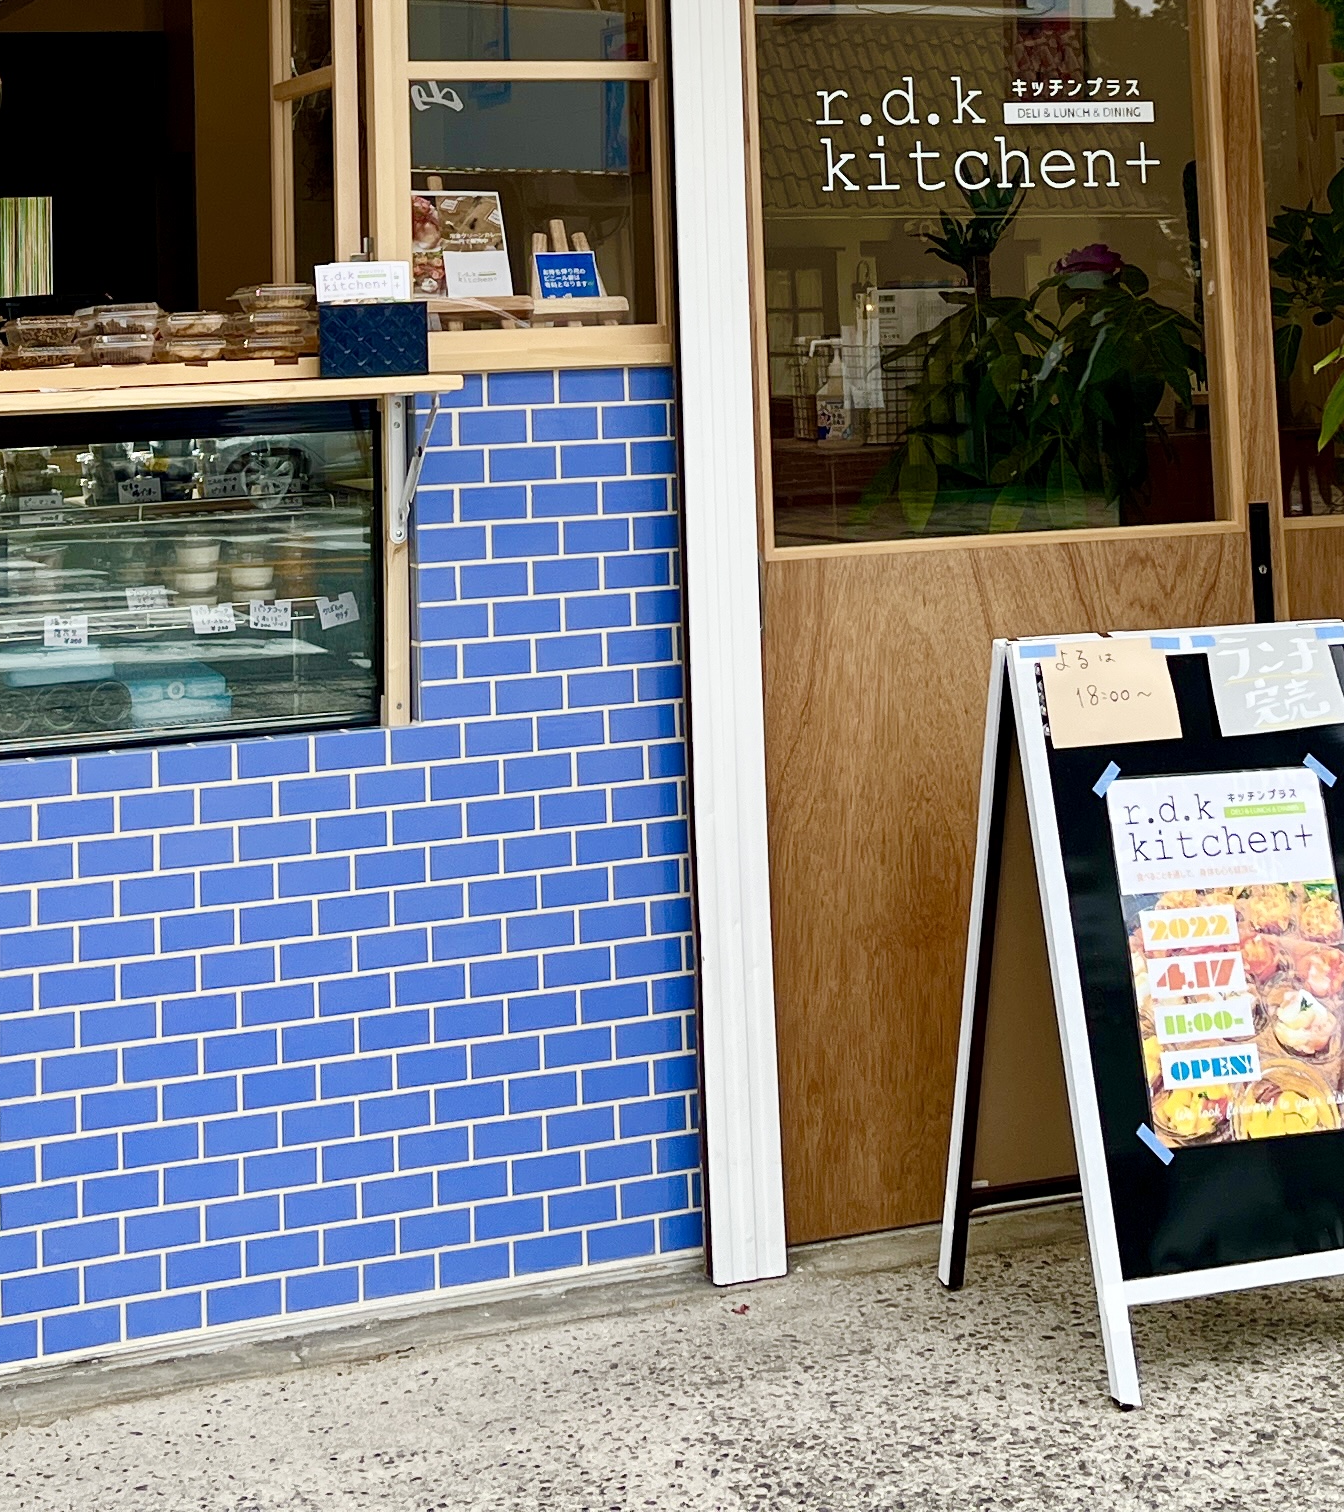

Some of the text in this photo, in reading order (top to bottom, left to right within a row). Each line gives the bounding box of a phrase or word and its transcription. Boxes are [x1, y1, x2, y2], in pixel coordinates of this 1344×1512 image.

[815, 76, 987, 126] r.d.k
[1011, 76, 1141, 97] キッチンプラス
[1017, 107, 1040, 118] DELI
[1053, 107, 1090, 118] LUNCH
[1103, 106, 1141, 118] DINING
[820, 135, 1161, 192] kitchen+
[1215, 637, 1318, 681] ランチ
[1244, 678, 1331, 727] 完売
[1123, 794, 1216, 826] r.d.k
[1227, 788, 1298, 803] キッチンプラス
[1129, 824, 1313, 863] kitchen+
[1147, 913, 1230, 942] 2022
[1156, 957, 1237, 991] 4.17
[1170, 1053, 1255, 1082] OPEN!
